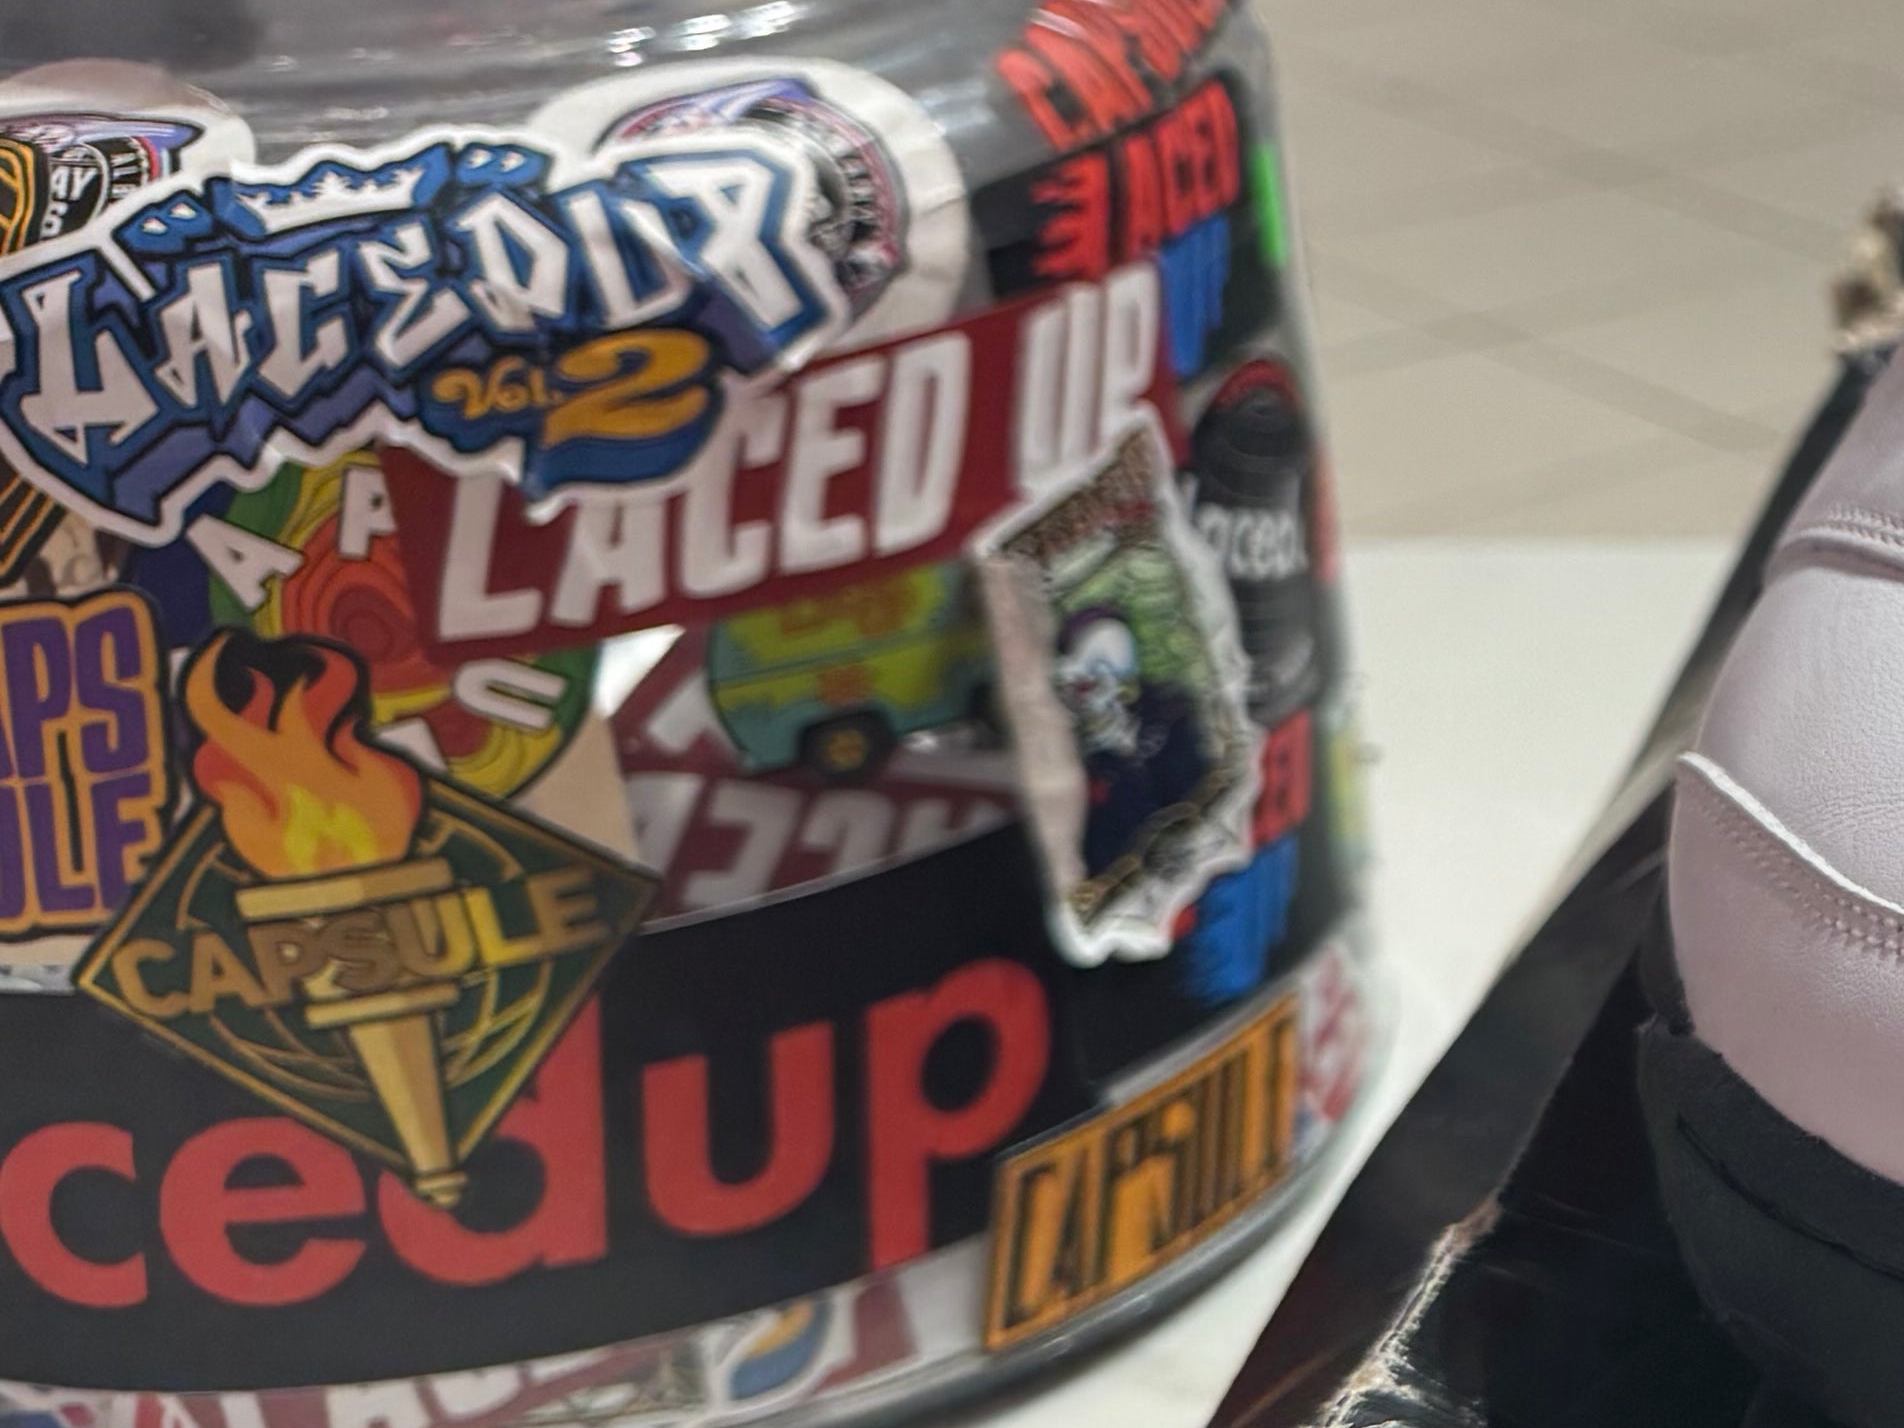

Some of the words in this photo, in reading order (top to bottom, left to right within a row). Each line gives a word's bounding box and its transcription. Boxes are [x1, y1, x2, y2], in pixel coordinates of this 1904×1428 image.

[540, 329, 712, 444] 2
[438, 330, 972, 644] LACED
[113, 870, 610, 1018] CAPSULE
